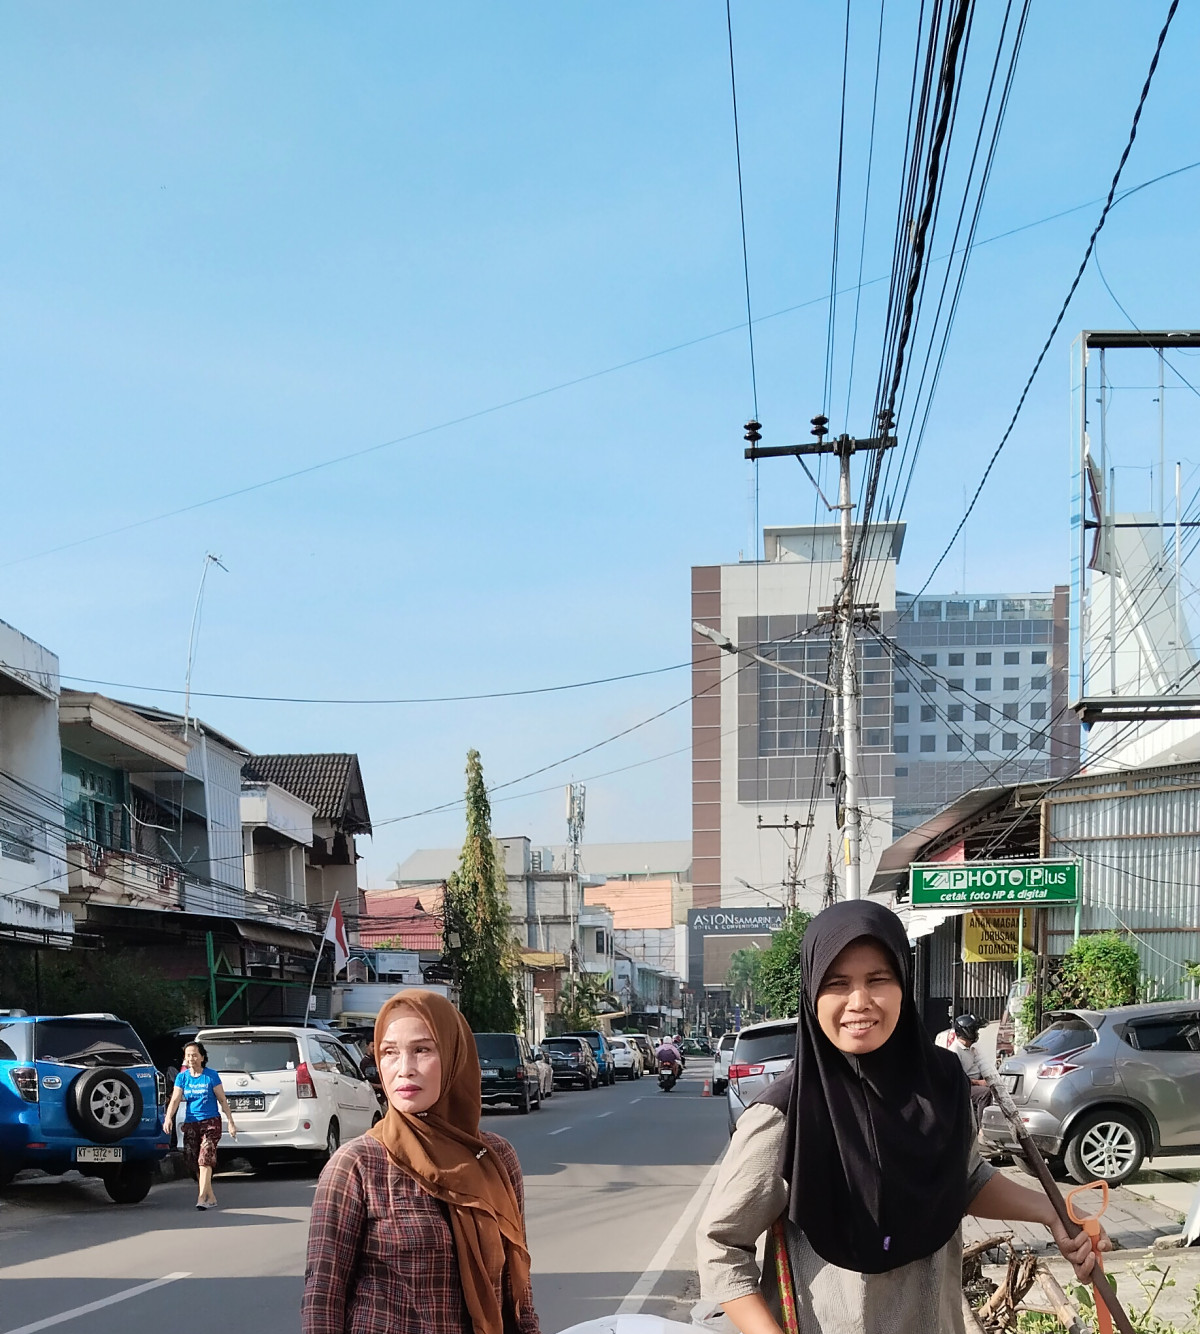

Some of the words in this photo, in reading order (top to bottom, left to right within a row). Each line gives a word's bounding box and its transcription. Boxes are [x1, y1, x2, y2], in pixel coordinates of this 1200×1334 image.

[951, 870, 1024, 889] PHOTO
[1027, 868, 1067, 887] Plus
[940, 892, 967, 901] cetak
[970, 891, 991, 900] foto
[992, 890, 1006, 900] HP
[1007, 890, 1015, 899] &
[1017, 889, 1047, 901] digital
[694, 914, 734, 925] ASTON
[78, 1148, 86, 1157] KT
